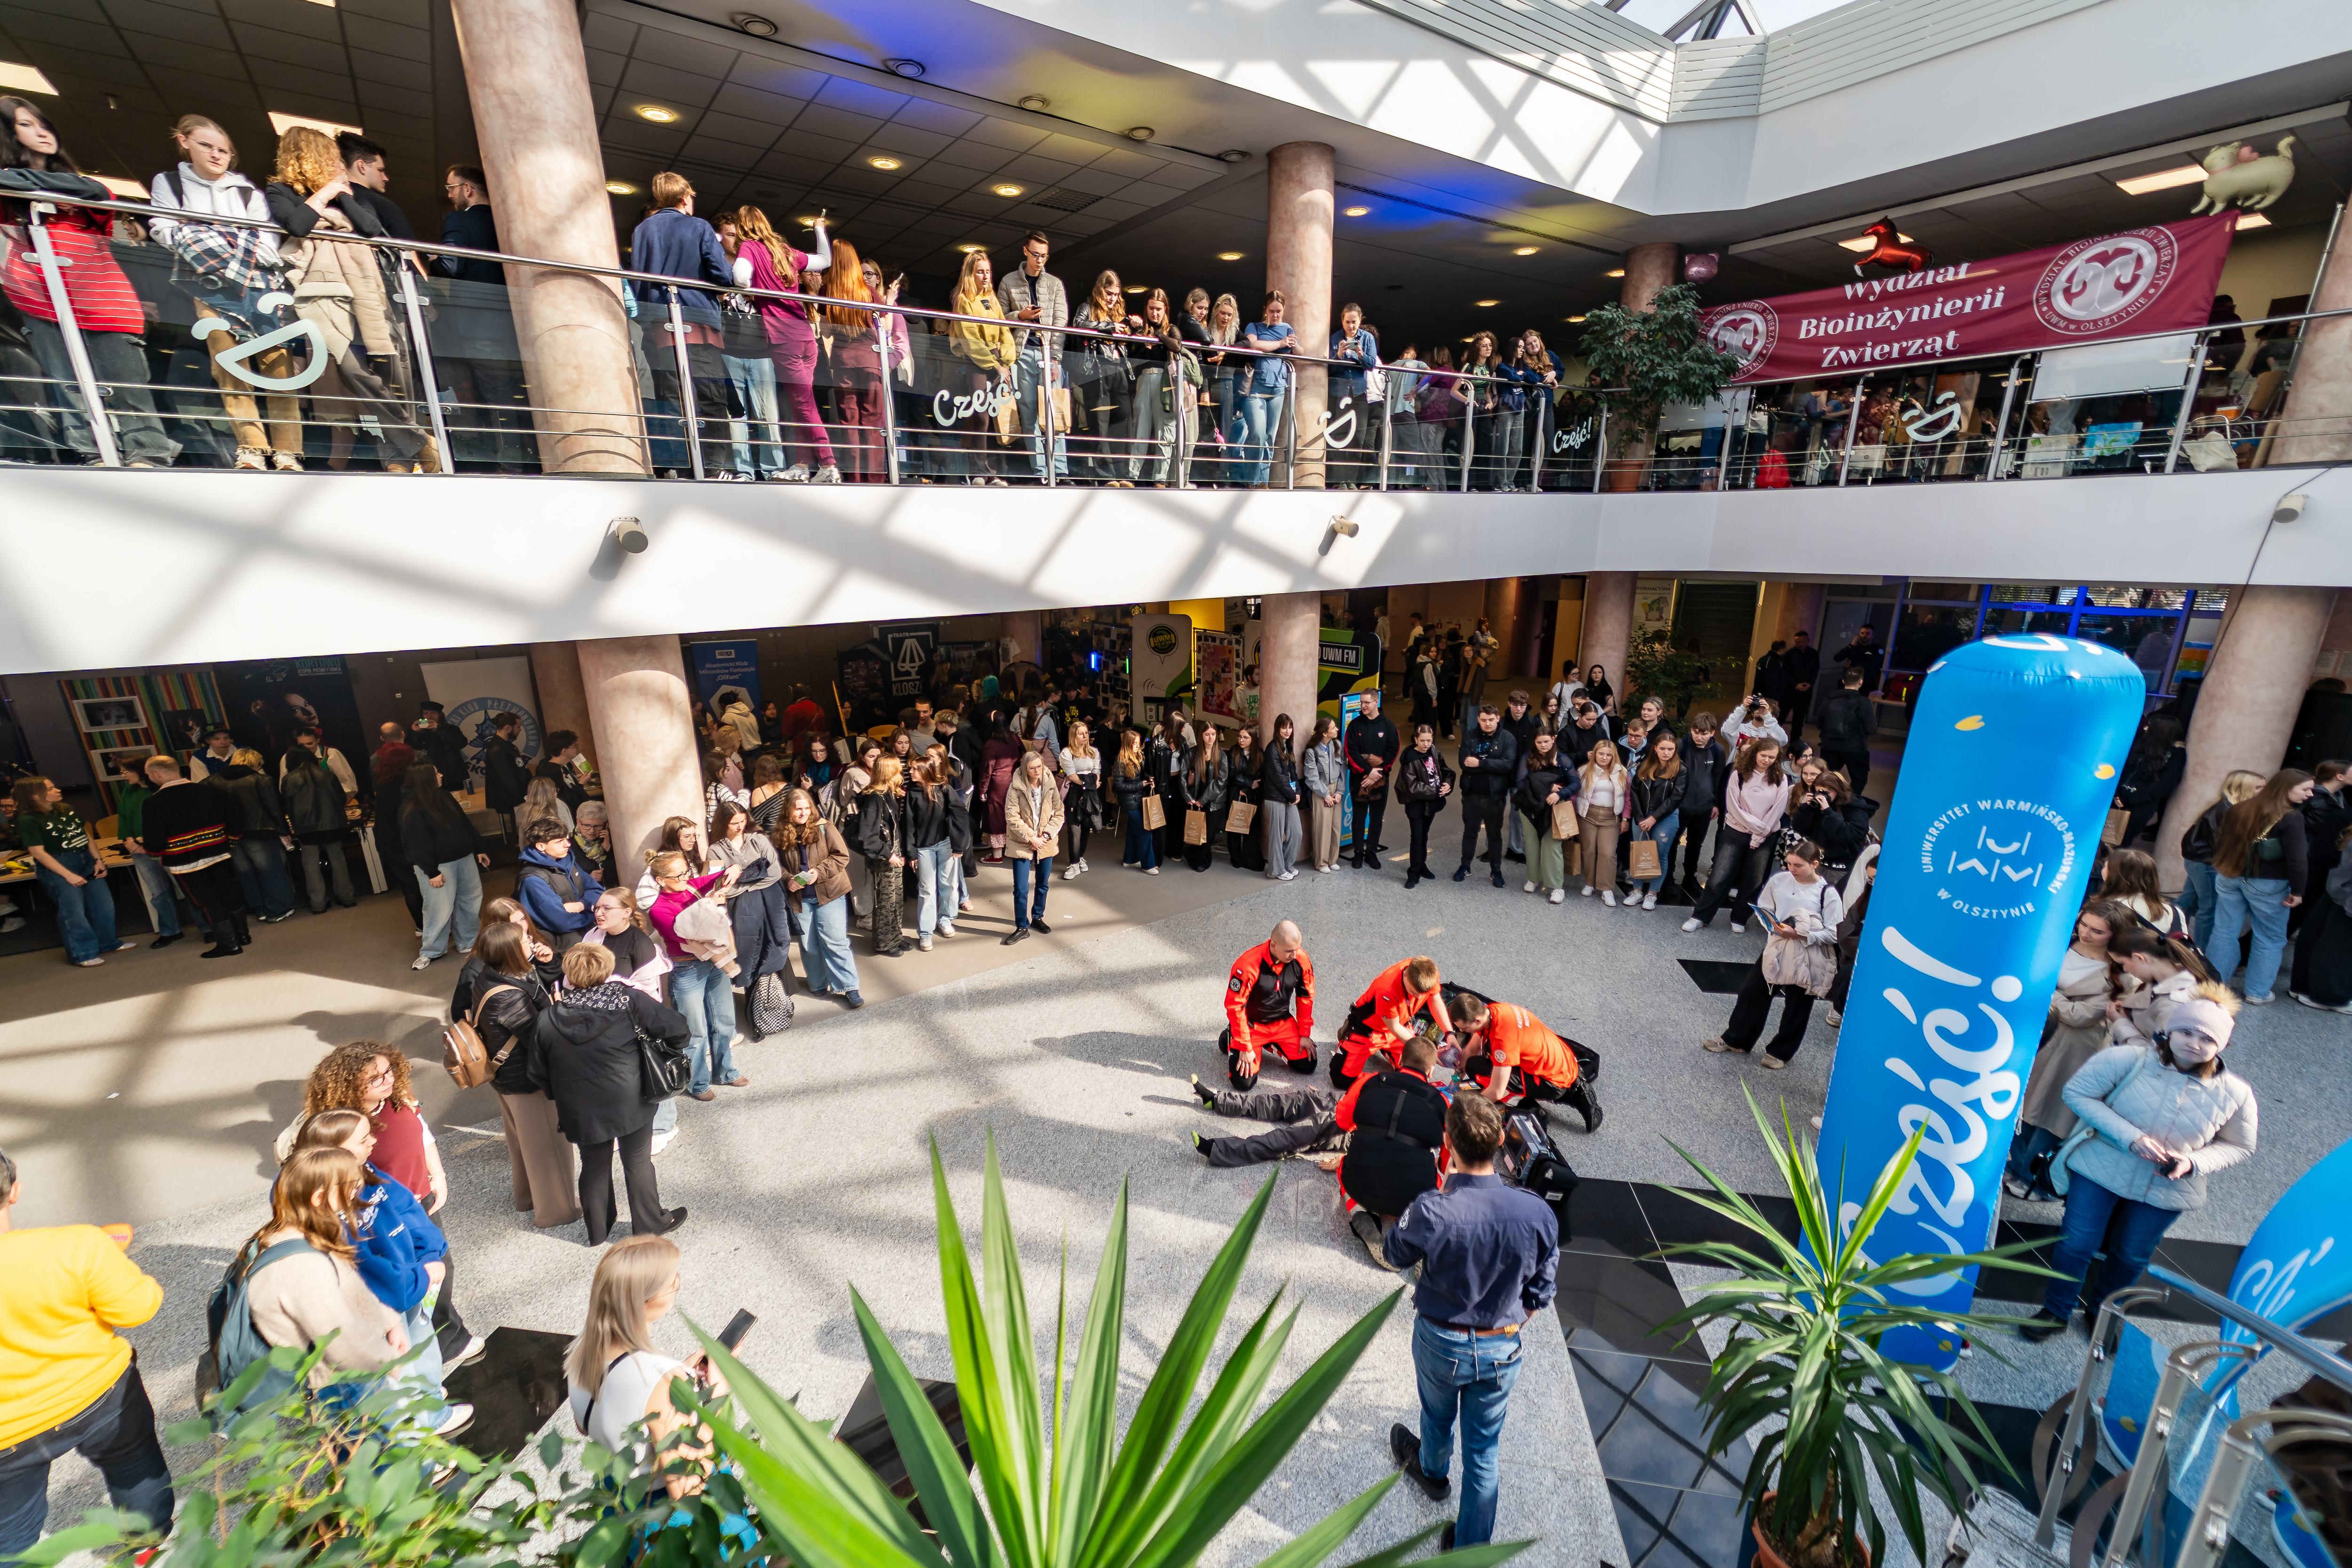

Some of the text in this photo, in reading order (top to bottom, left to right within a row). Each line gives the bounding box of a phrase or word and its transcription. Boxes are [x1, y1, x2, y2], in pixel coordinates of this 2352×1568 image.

[2039, 258, 2067, 305] WYDZIAŁ
[2153, 235, 2172, 286] ZWIERZĄT
[1798, 286, 2005, 340] Bioinżynierii
[2045, 311, 2068, 328] UWM
[2081, 296, 2148, 331] OLSZTYNIE
[1821, 330, 1960, 367] Zwierząt
[933, 364, 1022, 427] Cześć!
[1554, 416, 1592, 453] Cześć!
[295, 657, 340, 668] KORTOWO
[1323, 647, 1342, 662] UWM
[1344, 649, 1356, 663] FM
[458, 701, 479, 716] KLUB
[1921, 799, 2075, 894] UNIWERSYTET WARMIŃSKO-MAZURSKI
[1937, 887, 2035, 919] W OLSZTYNIE
[1840, 926, 2023, 1297] Cześć!
